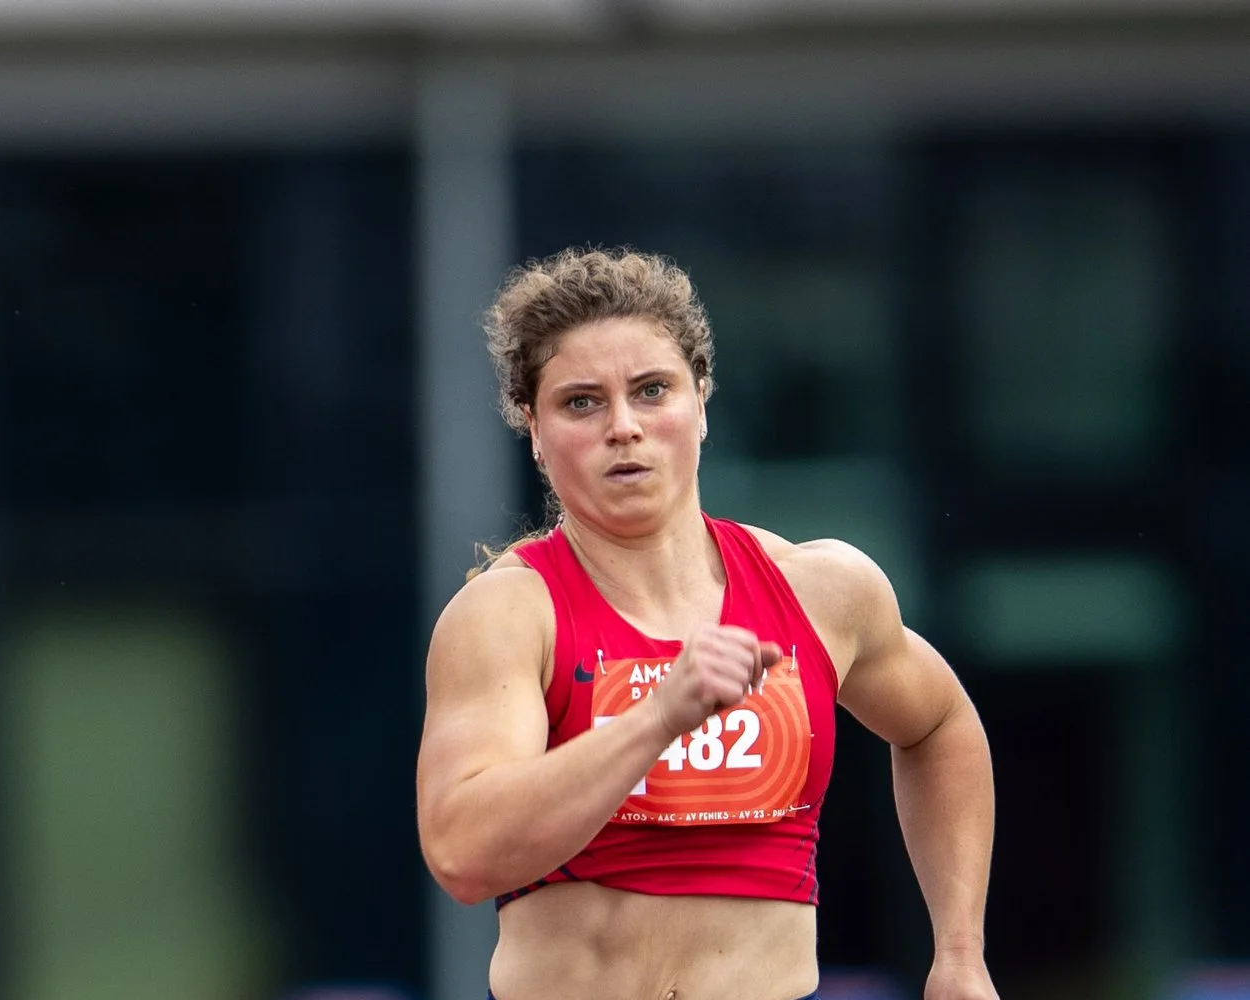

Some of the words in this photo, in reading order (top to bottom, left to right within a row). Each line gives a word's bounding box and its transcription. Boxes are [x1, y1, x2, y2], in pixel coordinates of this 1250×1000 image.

[657, 708, 763, 771] 482
[621, 812, 648, 822] ATOS
[657, 813, 677, 822] AAC
[686, 812, 697, 821] AV
[698, 811, 729, 821] FENIKS
[738, 810, 750, 820] AV
[753, 809, 765, 819] 23
